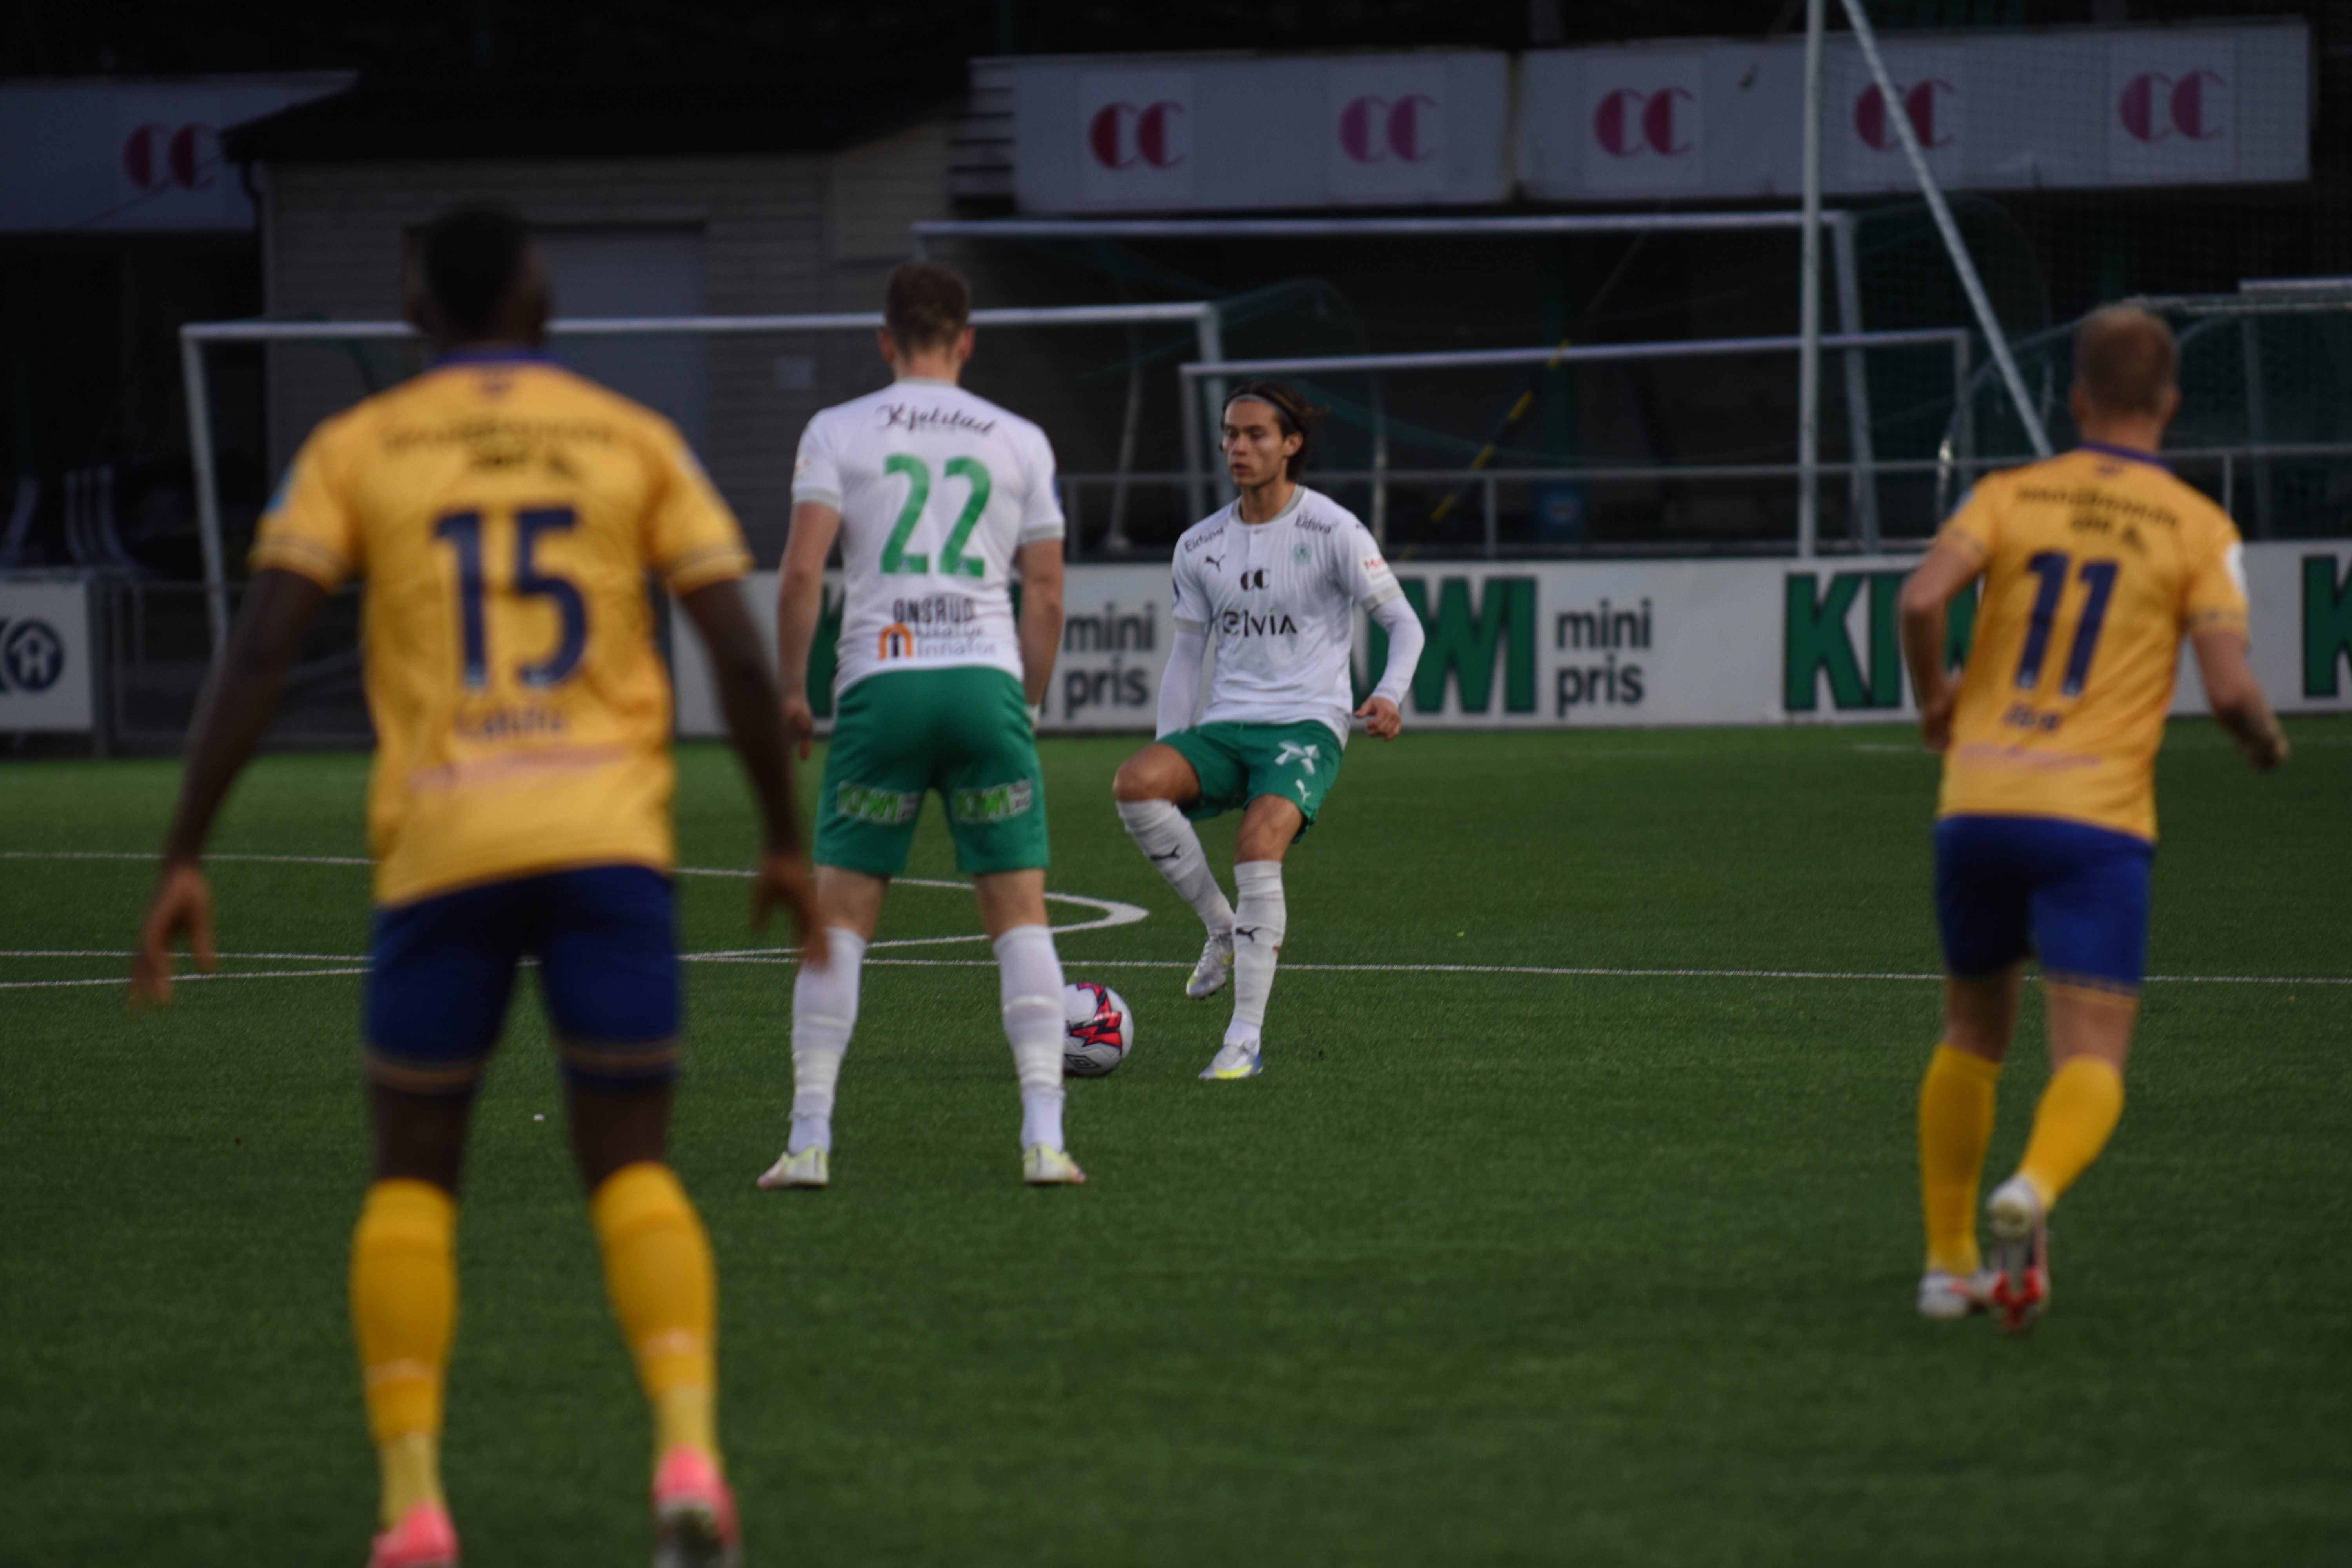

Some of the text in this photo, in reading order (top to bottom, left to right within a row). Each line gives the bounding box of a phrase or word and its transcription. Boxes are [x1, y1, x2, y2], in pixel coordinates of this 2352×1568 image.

[880, 454, 990, 578] 22
[433, 505, 590, 692] 15
[1064, 604, 1156, 652] mini
[1556, 598, 1651, 650] mini
[2016, 550, 2118, 698] 11
[1064, 658, 1149, 719] pris
[1556, 655, 1644, 719] pris
